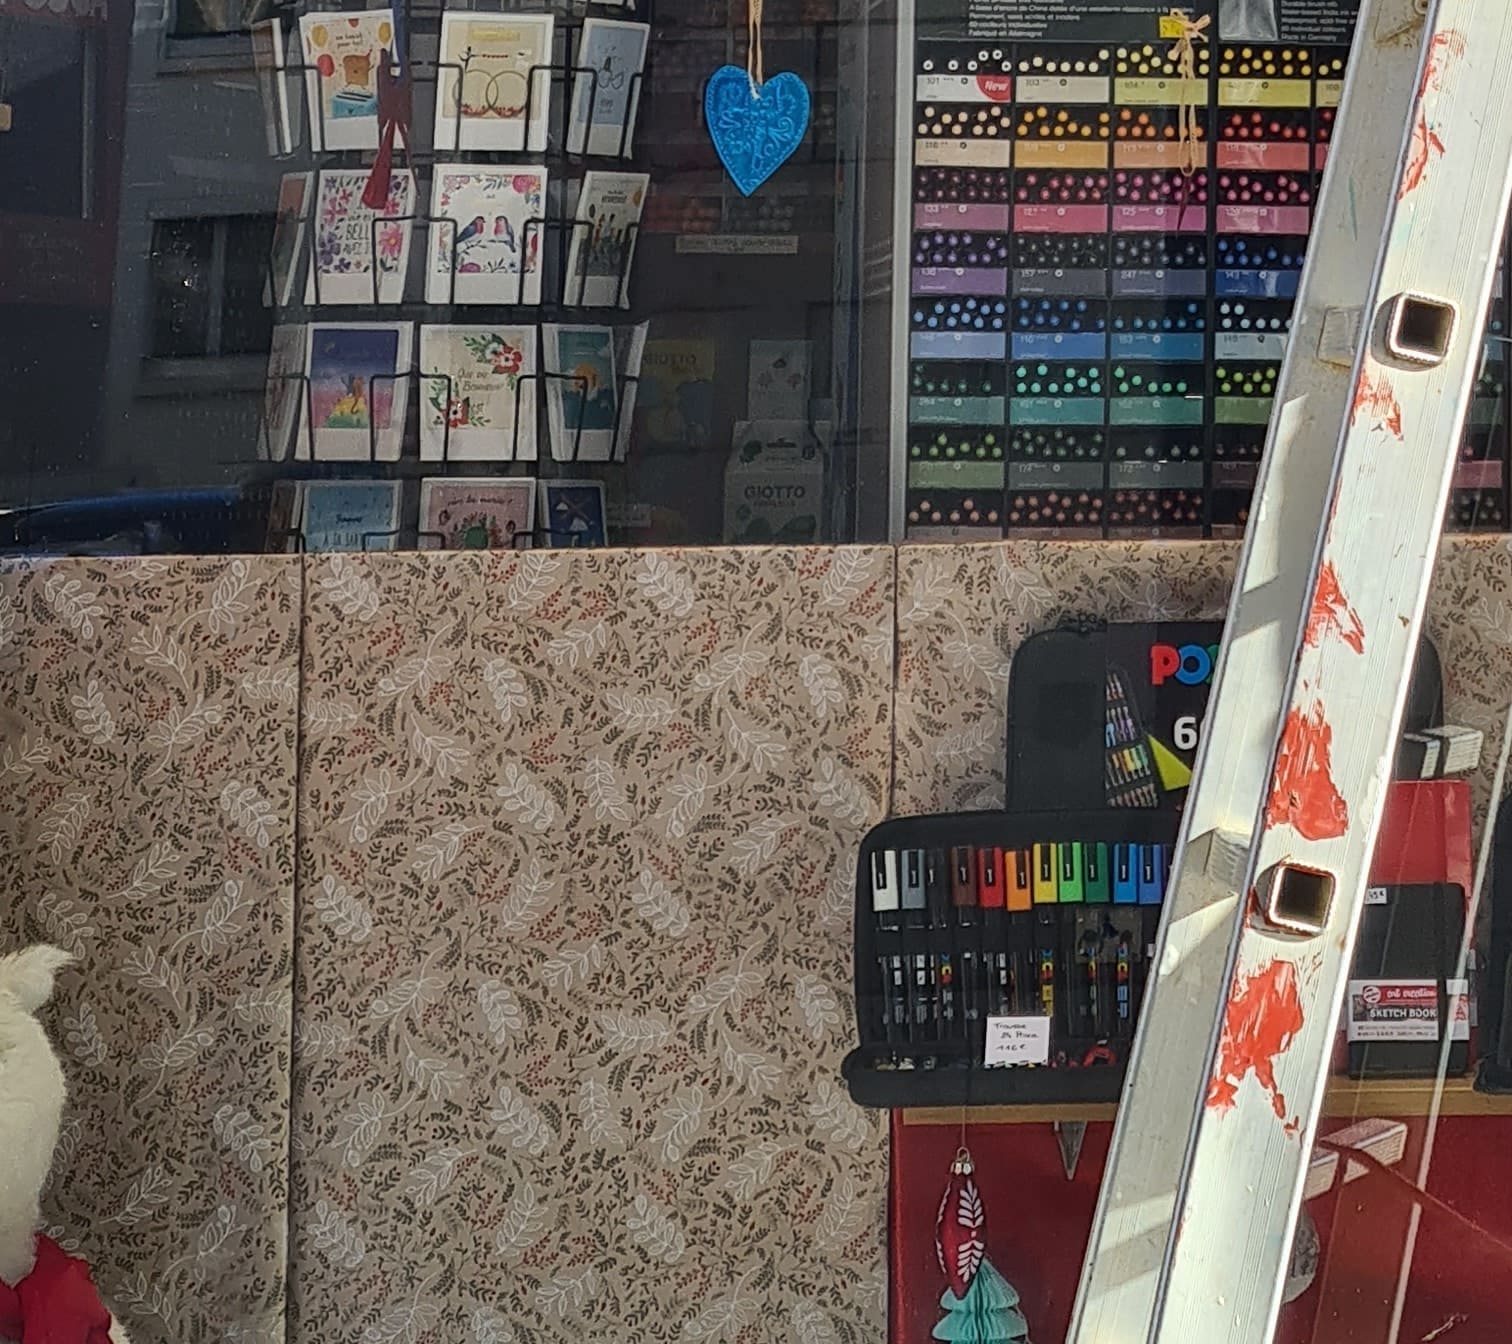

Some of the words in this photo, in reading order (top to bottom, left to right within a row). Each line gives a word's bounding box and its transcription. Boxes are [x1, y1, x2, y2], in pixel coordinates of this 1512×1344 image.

[984, 79, 1008, 92] New
[744, 484, 806, 500] GIOTTO
[1369, 1008, 1407, 1018] SKETCH
[1409, 1007, 1437, 1018] BOOK
